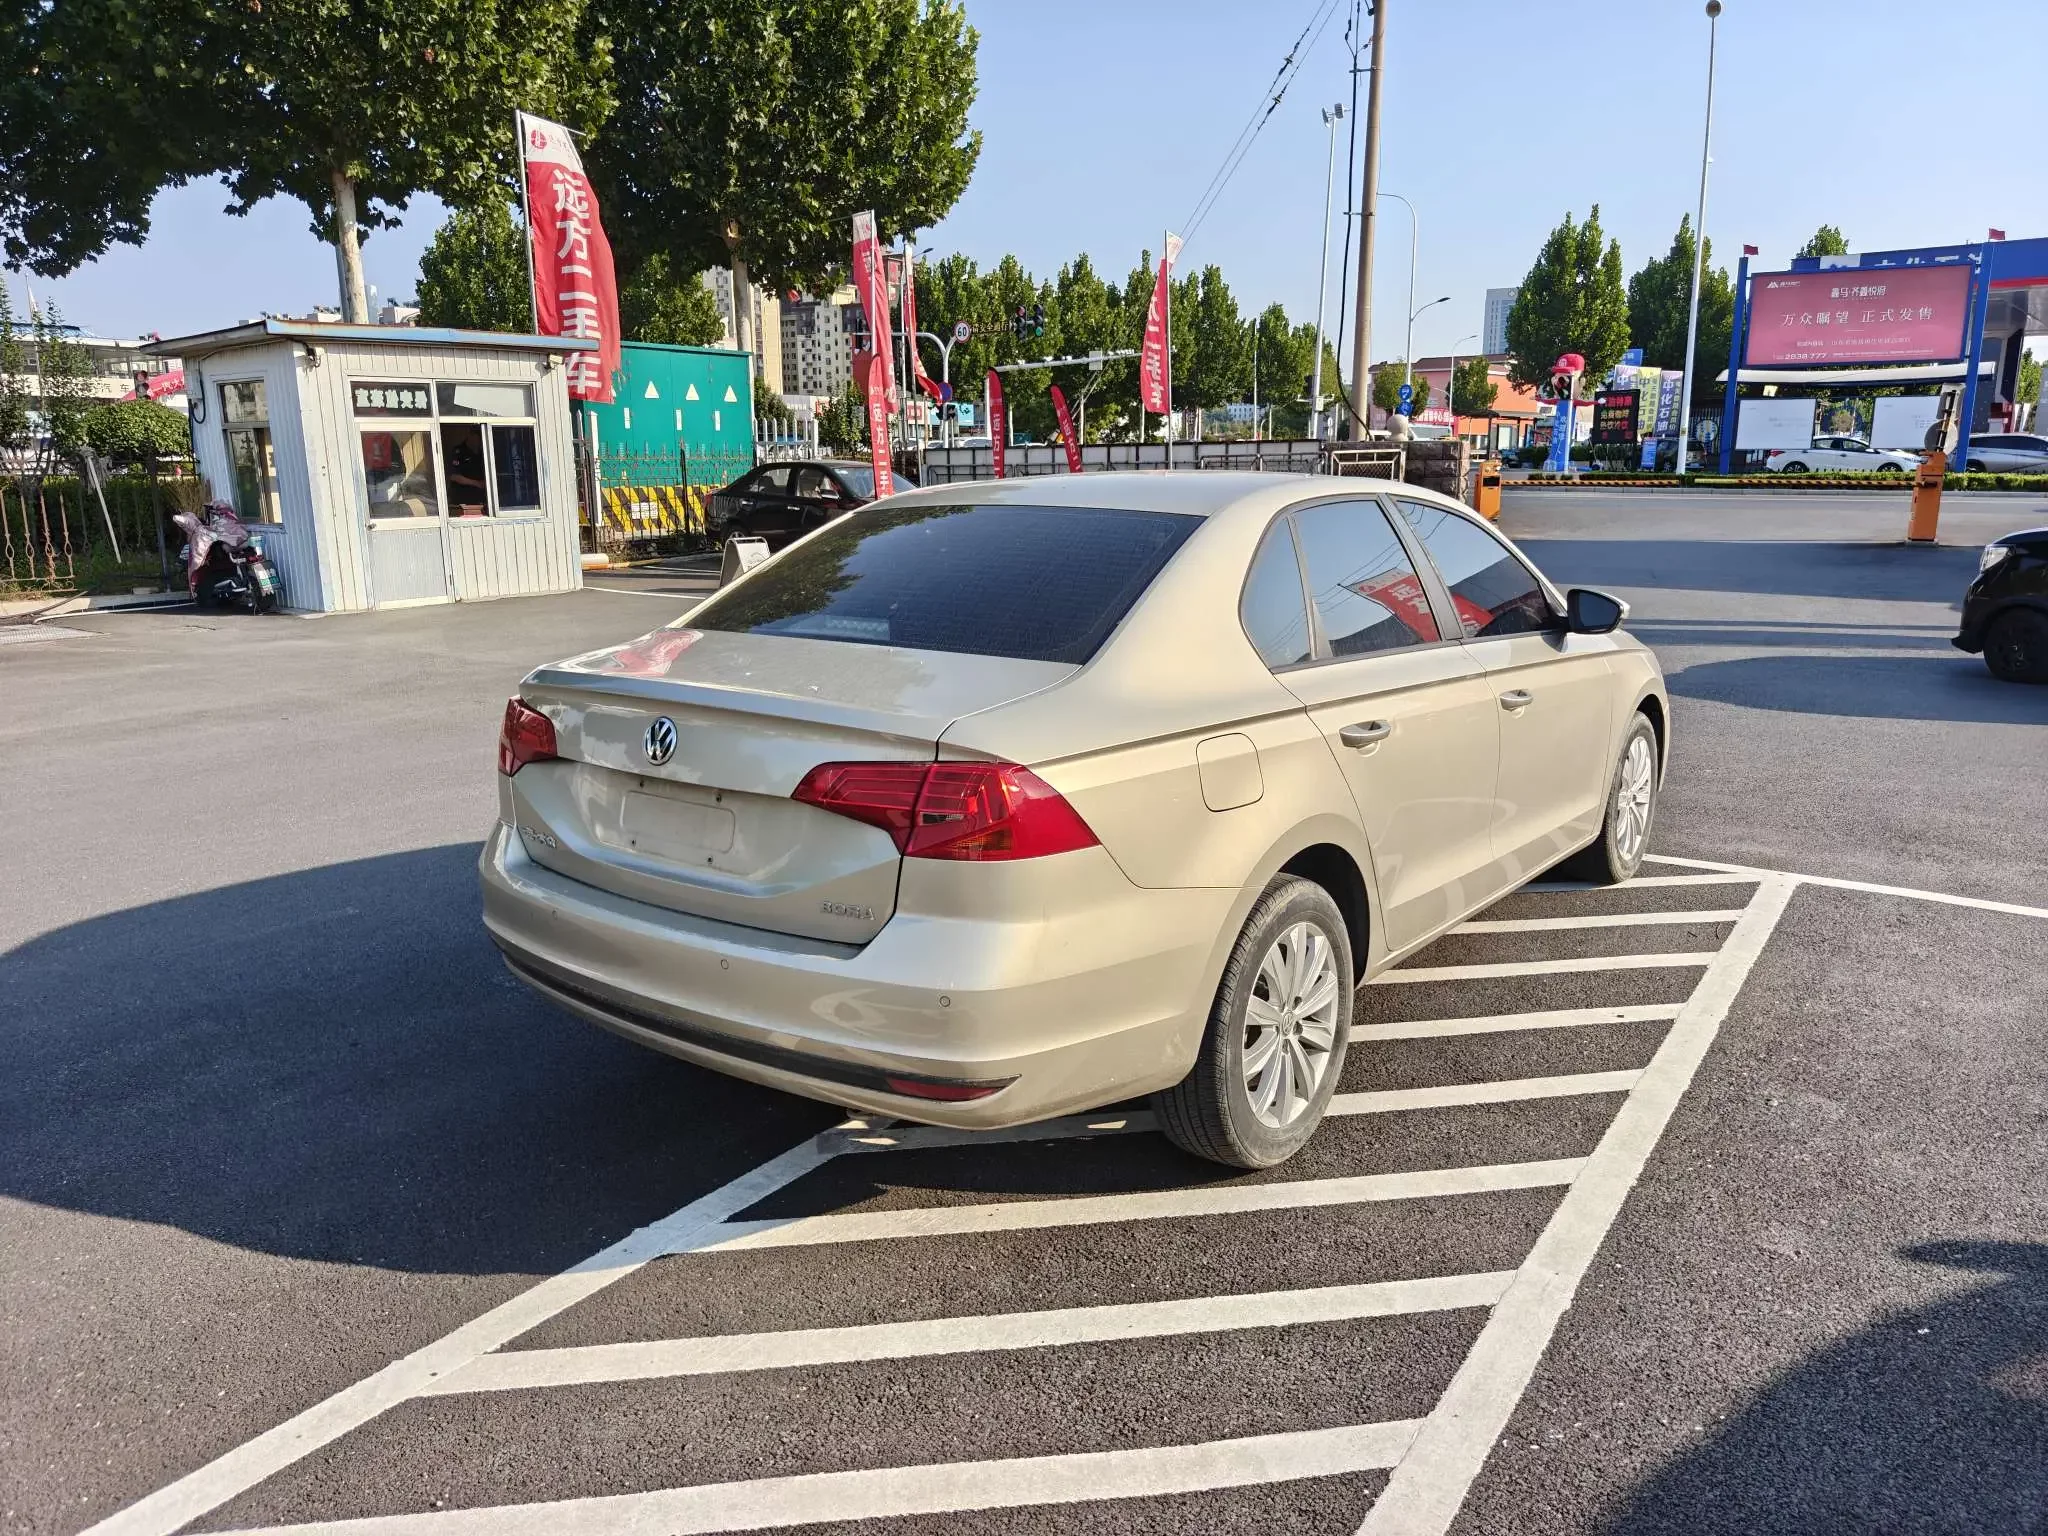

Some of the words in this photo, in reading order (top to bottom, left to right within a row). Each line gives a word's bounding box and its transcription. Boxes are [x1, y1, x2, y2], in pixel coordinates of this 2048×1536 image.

[552, 168, 602, 395] 远方二手车
[957, 326, 967, 337] 60
[1861, 305, 1935, 324] 正式发售
[1657, 379, 1675, 432] 中化石油
[873, 403, 889, 500] 远方二手
[821, 900, 877, 921] BORA
